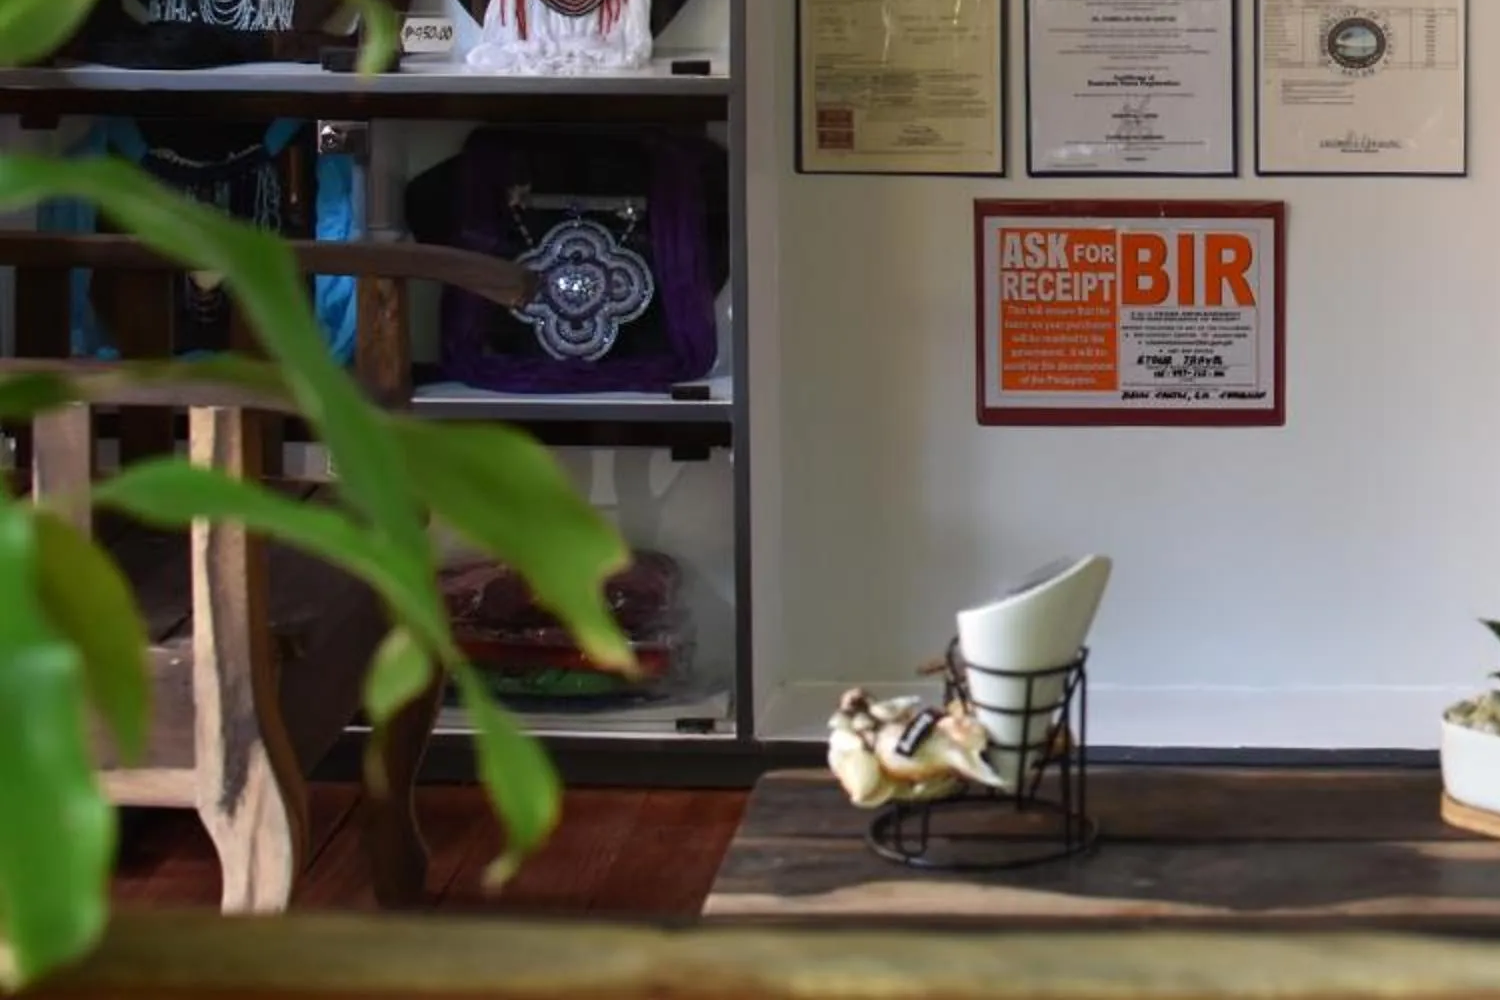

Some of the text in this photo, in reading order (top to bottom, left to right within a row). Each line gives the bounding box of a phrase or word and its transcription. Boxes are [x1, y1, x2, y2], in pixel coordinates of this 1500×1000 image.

[1002, 231, 1116, 269] ASK FOR
[1120, 232, 1257, 306] BIR
[1002, 271, 1115, 302] RECEIPT
